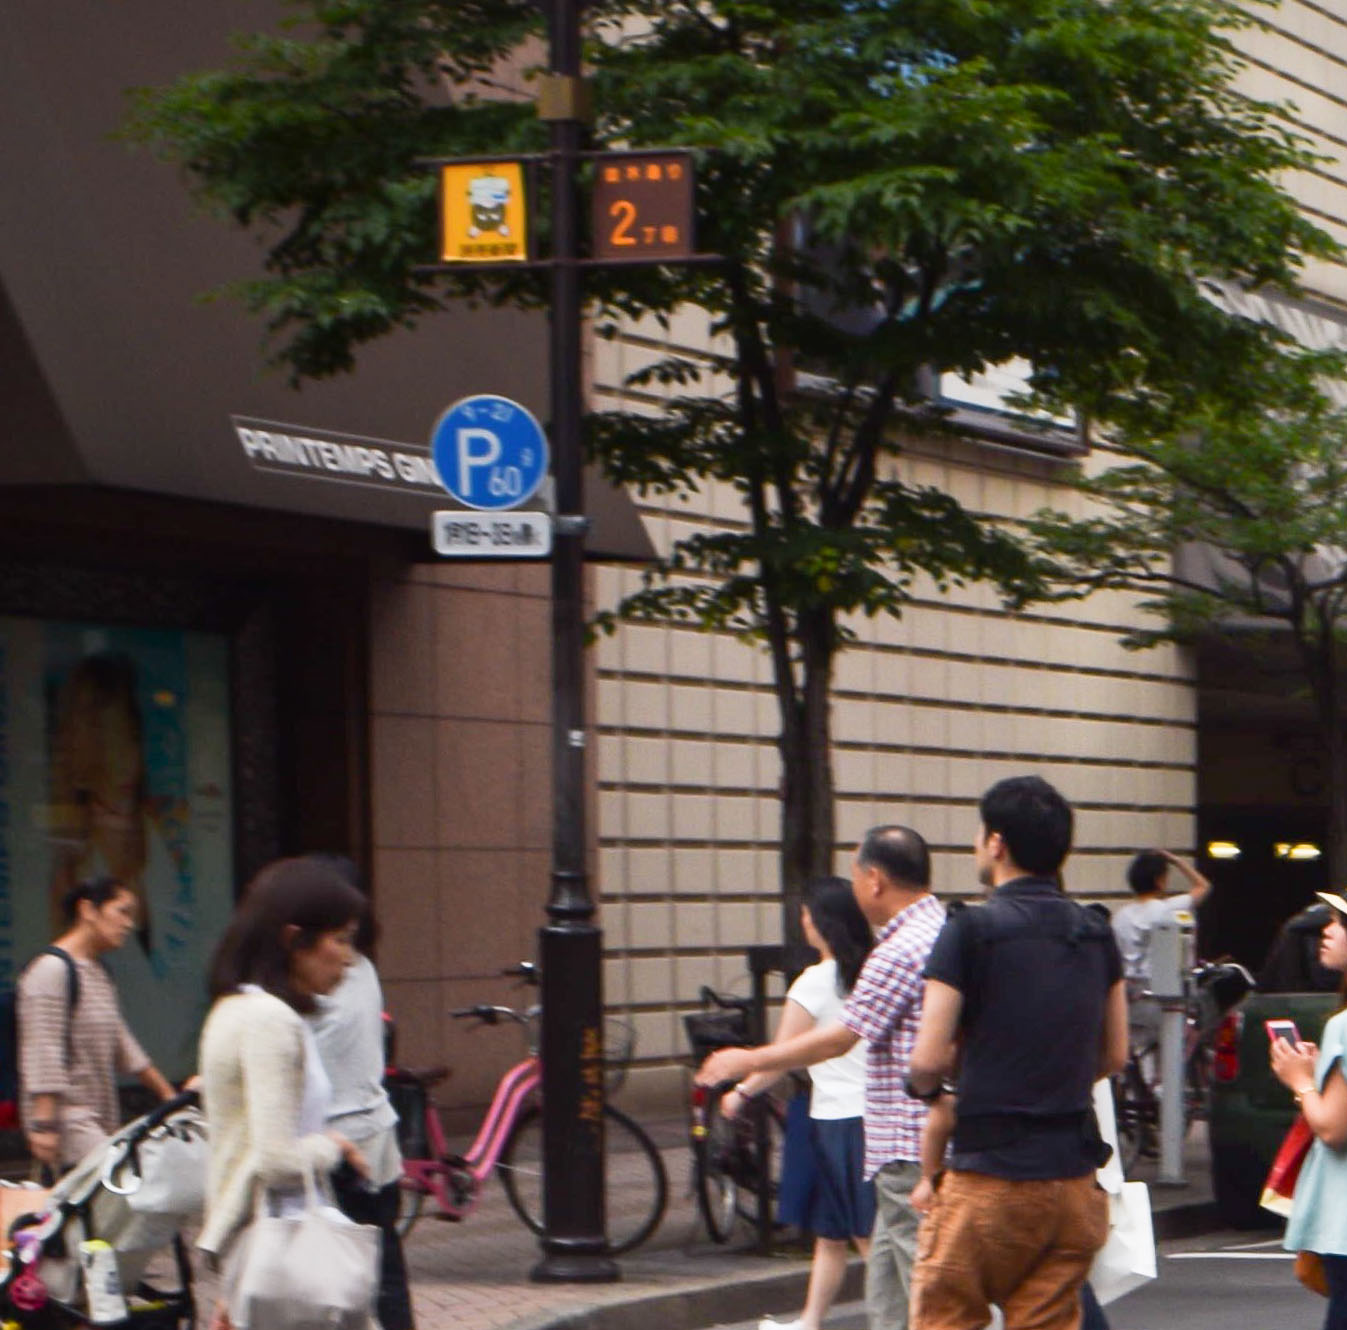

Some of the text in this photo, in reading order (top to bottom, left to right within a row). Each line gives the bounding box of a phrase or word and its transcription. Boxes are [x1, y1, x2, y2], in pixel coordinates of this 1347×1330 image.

[236, 426, 396, 480] PRINTEMPS
[456, 427, 501, 498] P
[487, 466, 522, 497] 60
